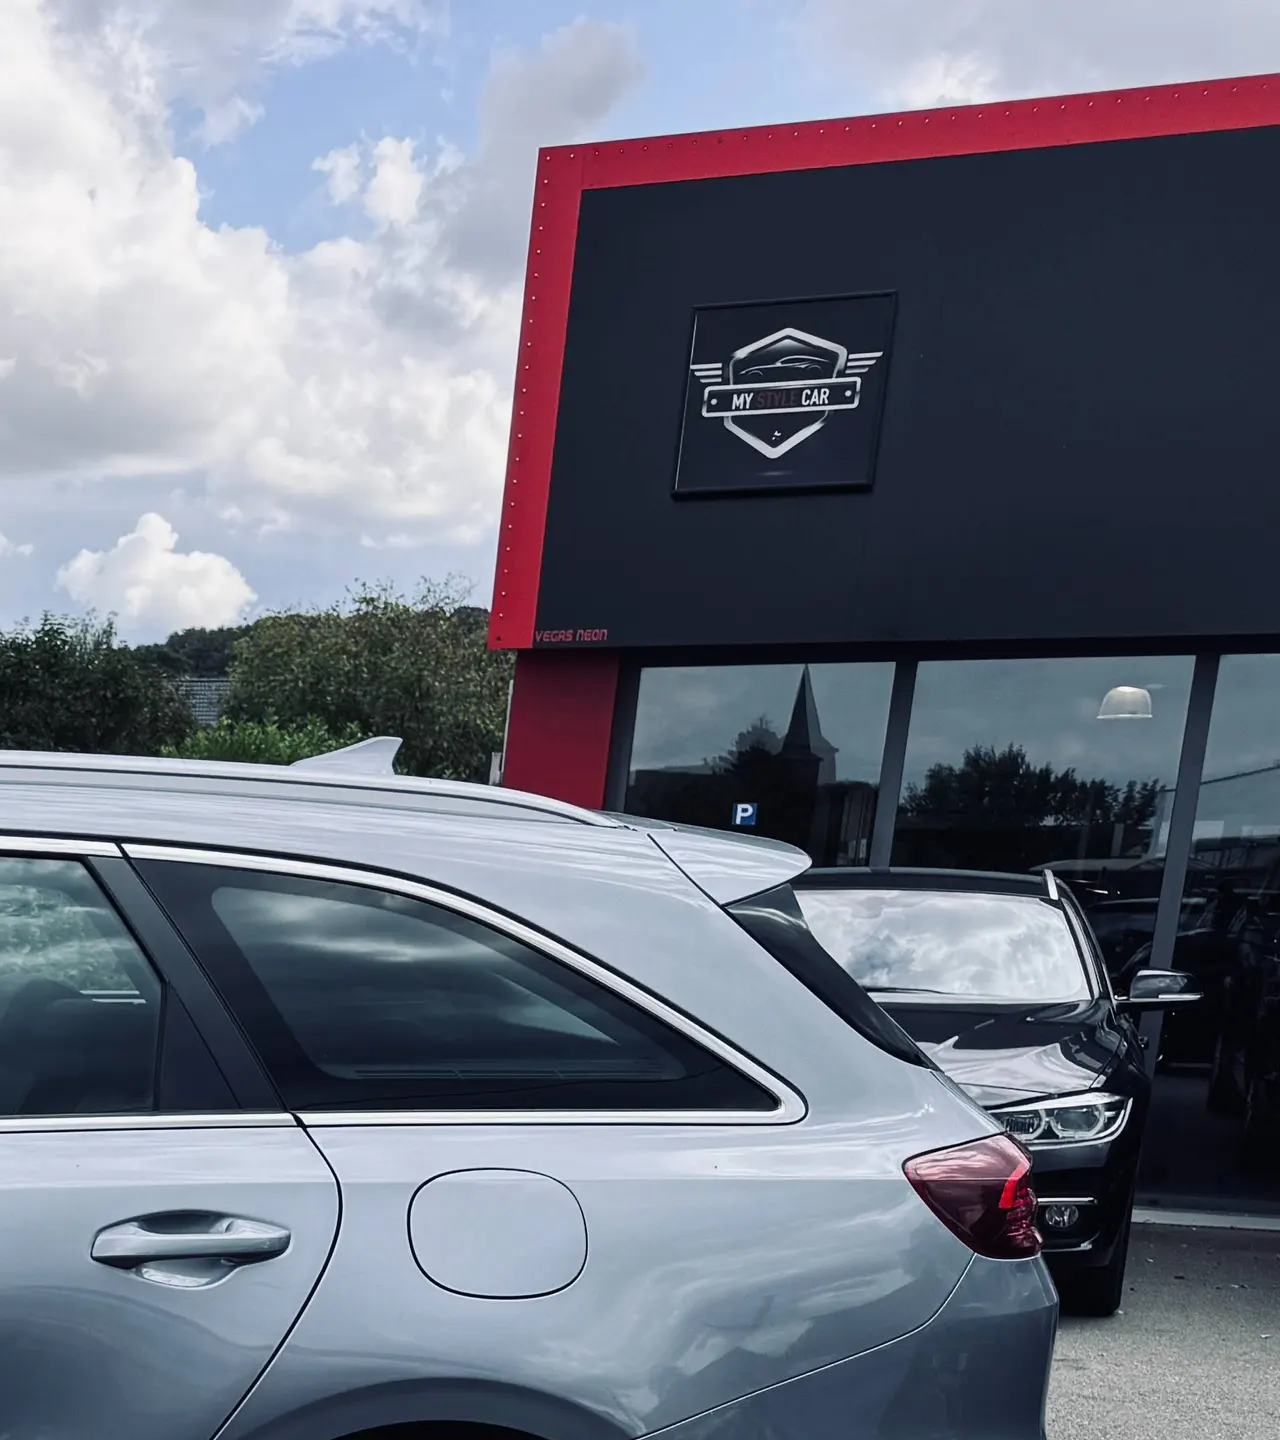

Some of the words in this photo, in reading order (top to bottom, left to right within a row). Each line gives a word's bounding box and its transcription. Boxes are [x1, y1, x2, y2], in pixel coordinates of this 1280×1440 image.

[731, 391, 754, 410] MY
[756, 390, 797, 408] STYLE
[801, 387, 830, 406] CAR
[535, 630, 573, 642] VEGAS
[575, 629, 608, 642] NEON
[735, 803, 754, 825] P
